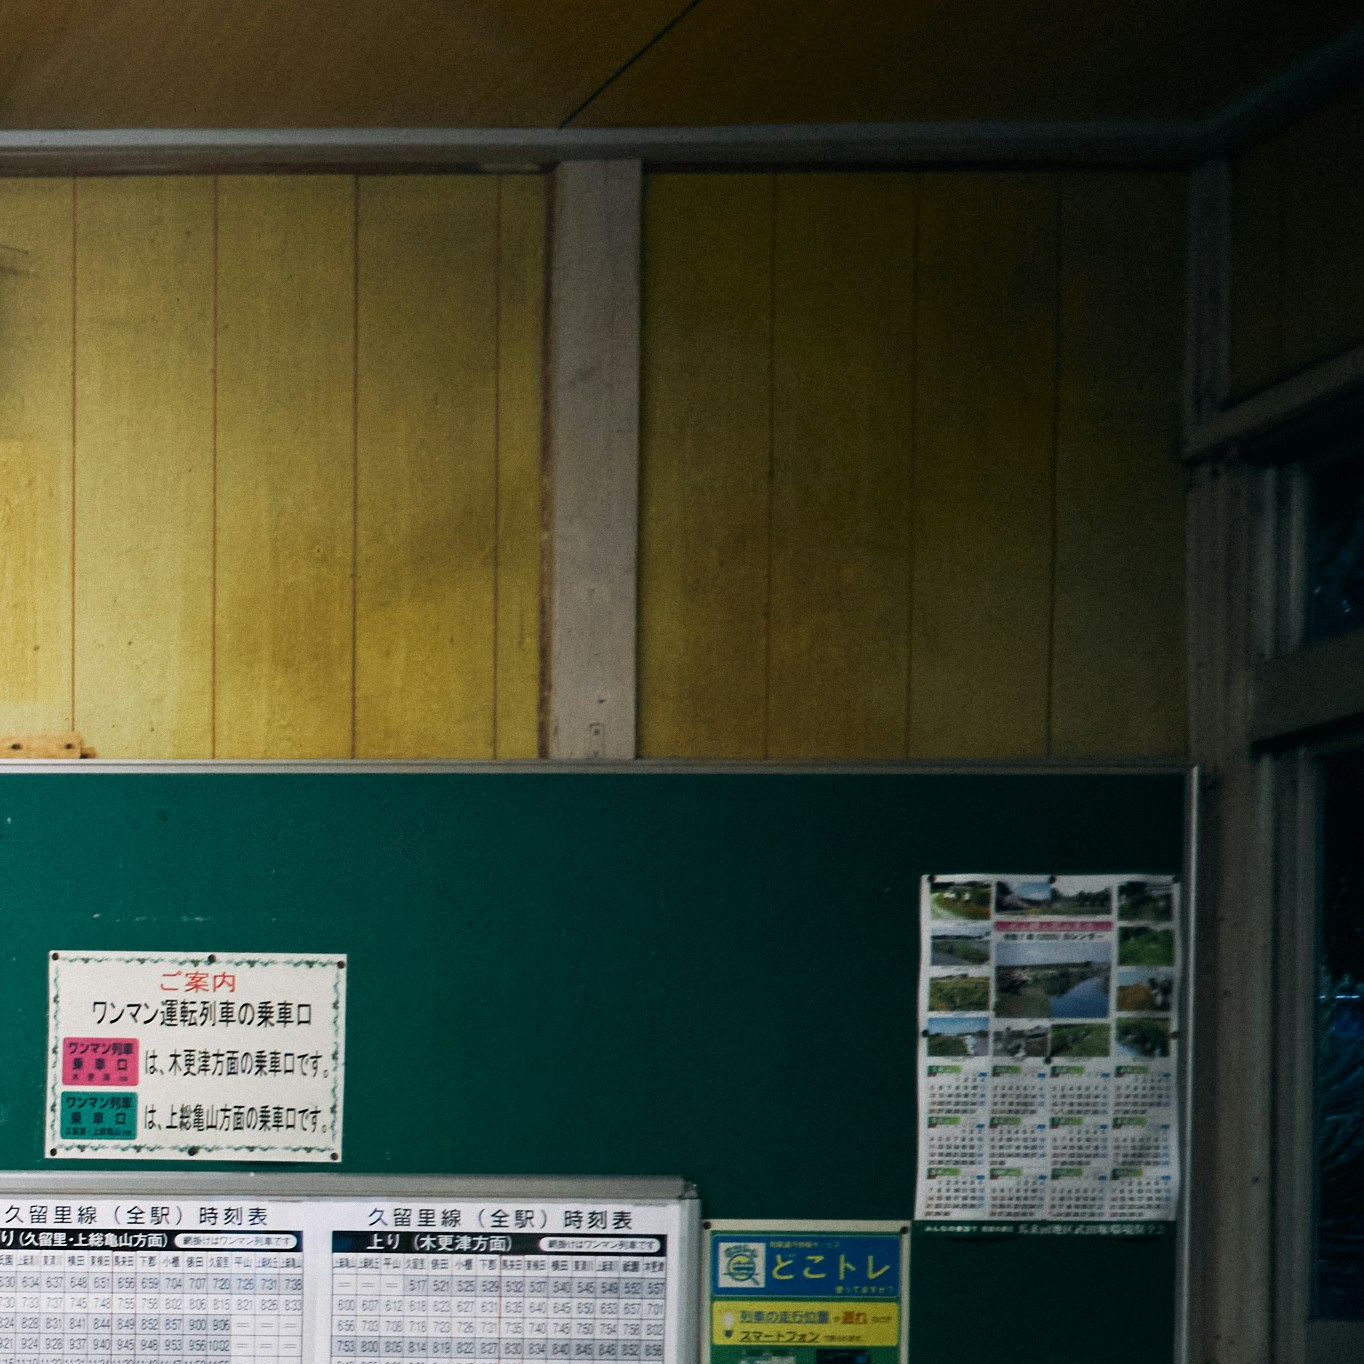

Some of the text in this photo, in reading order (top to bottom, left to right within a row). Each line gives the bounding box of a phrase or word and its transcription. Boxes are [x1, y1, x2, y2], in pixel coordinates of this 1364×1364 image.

[159, 970, 237, 993] ご案内
[92, 999, 312, 1028] ワンマン運転列車の乗車口
[68, 1042, 133, 1056] ワンマン列車
[144, 1049, 330, 1079] は、木更津方面の乗車口です。
[65, 1096, 132, 1109] ワンマン列車
[143, 1104, 329, 1134] は、上総亀山方面の乗車口です。
[4, 1204, 269, 1228] 久留里線（全駅）時刻表
[368, 1207, 634, 1231] 久留里線（全駅）時刻表
[367, 1235, 513, 1253] 上り (木更津方面)
[772, 1253, 890, 1280] どこトレ
[739, 1331, 820, 1343] スマートフォン
